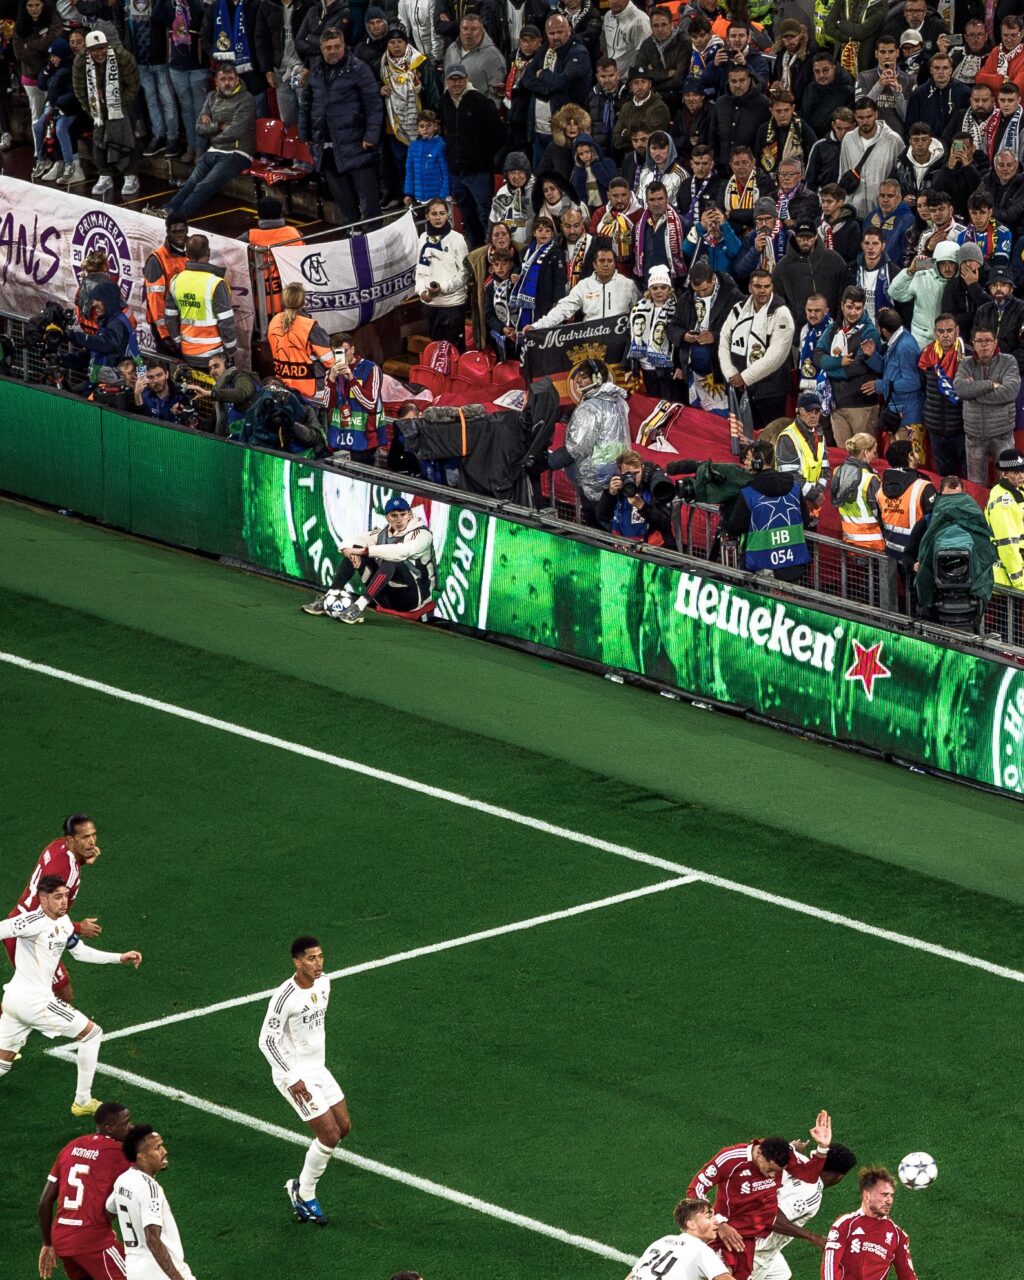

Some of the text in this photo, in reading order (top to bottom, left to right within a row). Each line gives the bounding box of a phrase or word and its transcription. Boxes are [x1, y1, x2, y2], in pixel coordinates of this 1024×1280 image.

[108, 54, 117, 82] Real
[79, 213, 124, 247] PRIMAVERA
[0, 212, 60, 285] ANS
[74, 249, 82, 261] 20
[539, 327, 612, 350] Madridista
[771, 530, 790, 545] HB
[770, 548, 794, 566] 054
[674, 572, 835, 672] Heineken
[64, 1163, 90, 1211] 5
